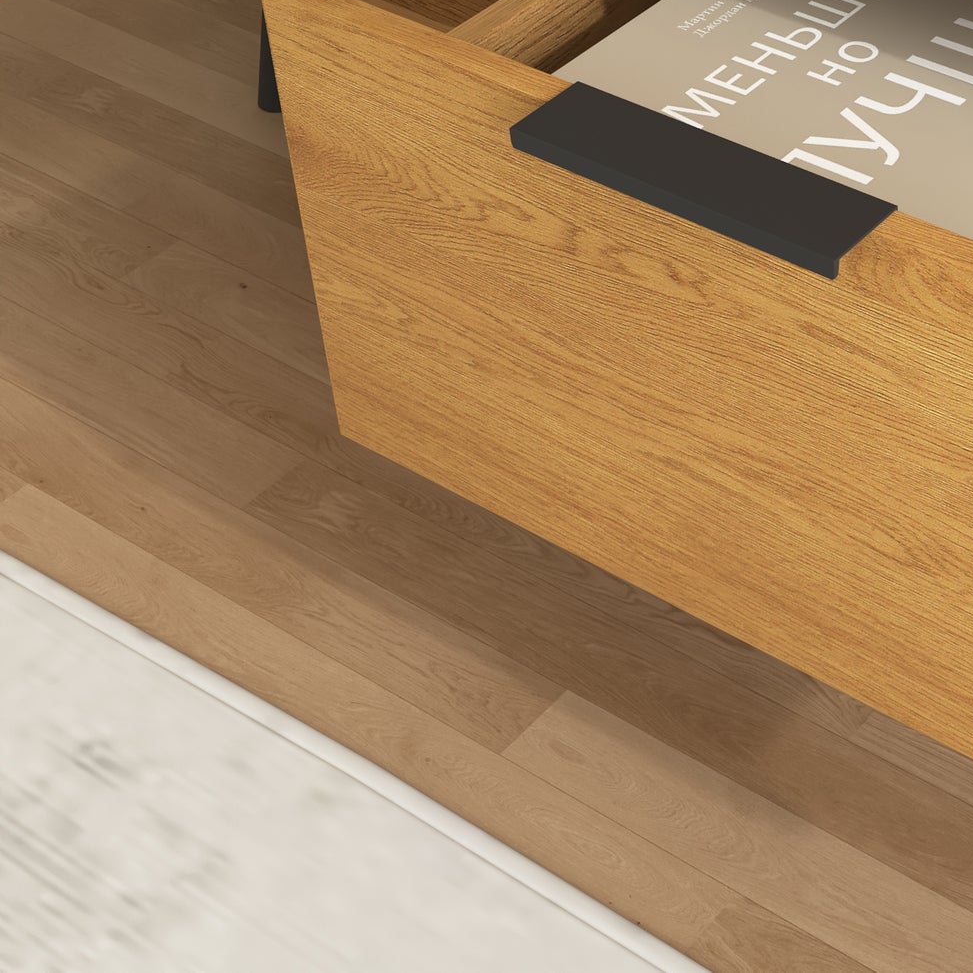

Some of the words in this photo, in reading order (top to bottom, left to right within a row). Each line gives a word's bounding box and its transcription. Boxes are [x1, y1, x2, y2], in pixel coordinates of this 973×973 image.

[677, 0, 725, 31] Мартин
[693, 1, 747, 39] Джордан
[806, 40, 879, 87] НО
